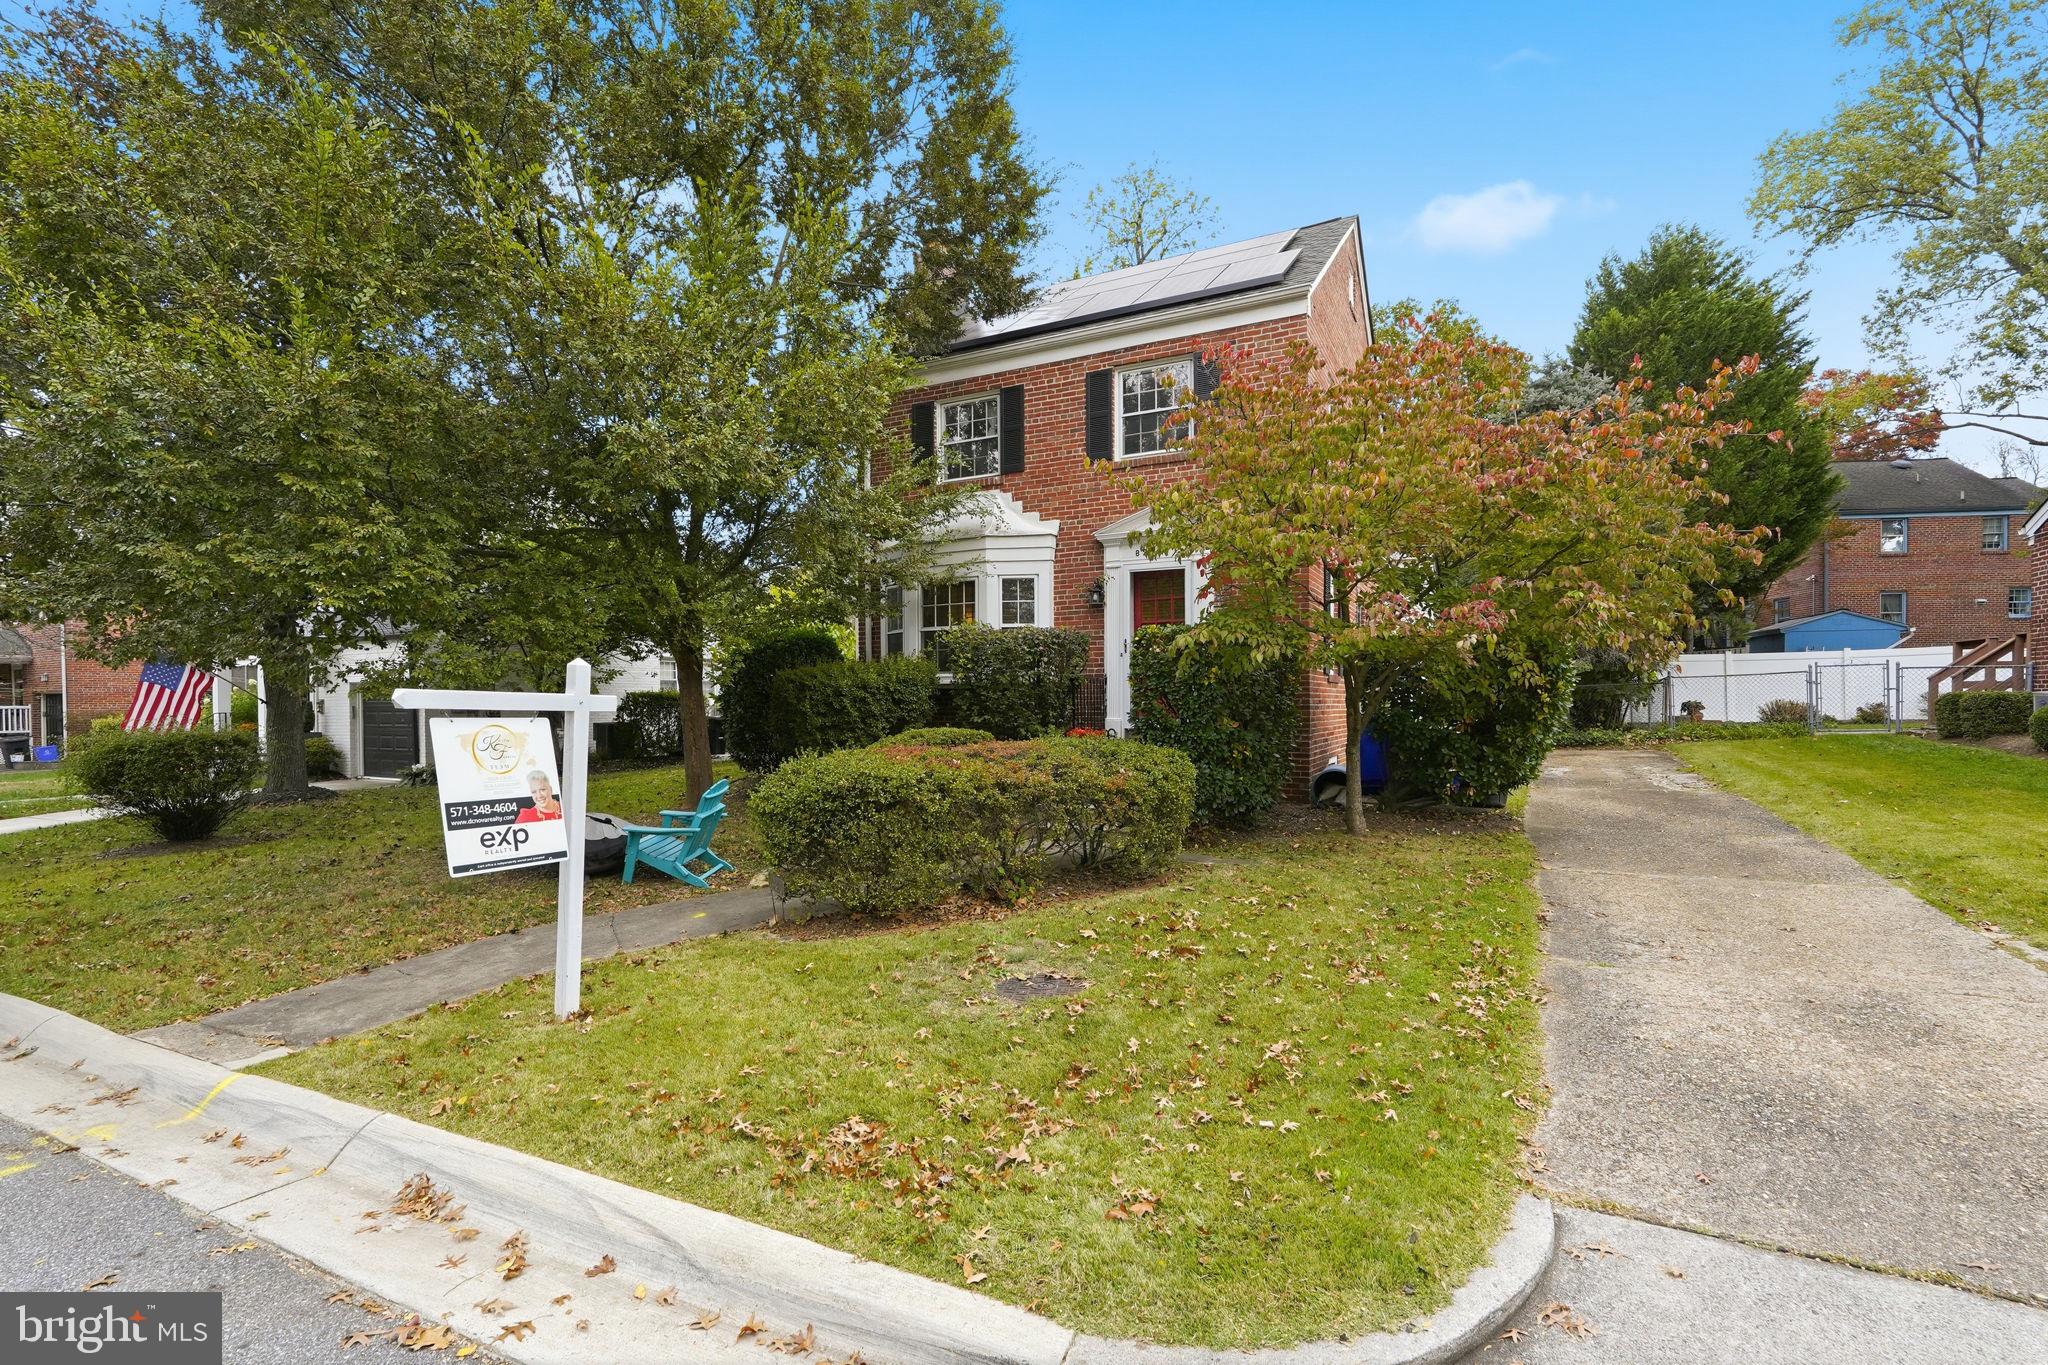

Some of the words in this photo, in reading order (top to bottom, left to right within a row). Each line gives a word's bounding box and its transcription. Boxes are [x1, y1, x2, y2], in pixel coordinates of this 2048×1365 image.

[450, 802, 518, 817] 571-348-4604
[451, 814, 516, 826] www.dcnovarealty.com
[484, 847, 513, 855] REALTY
